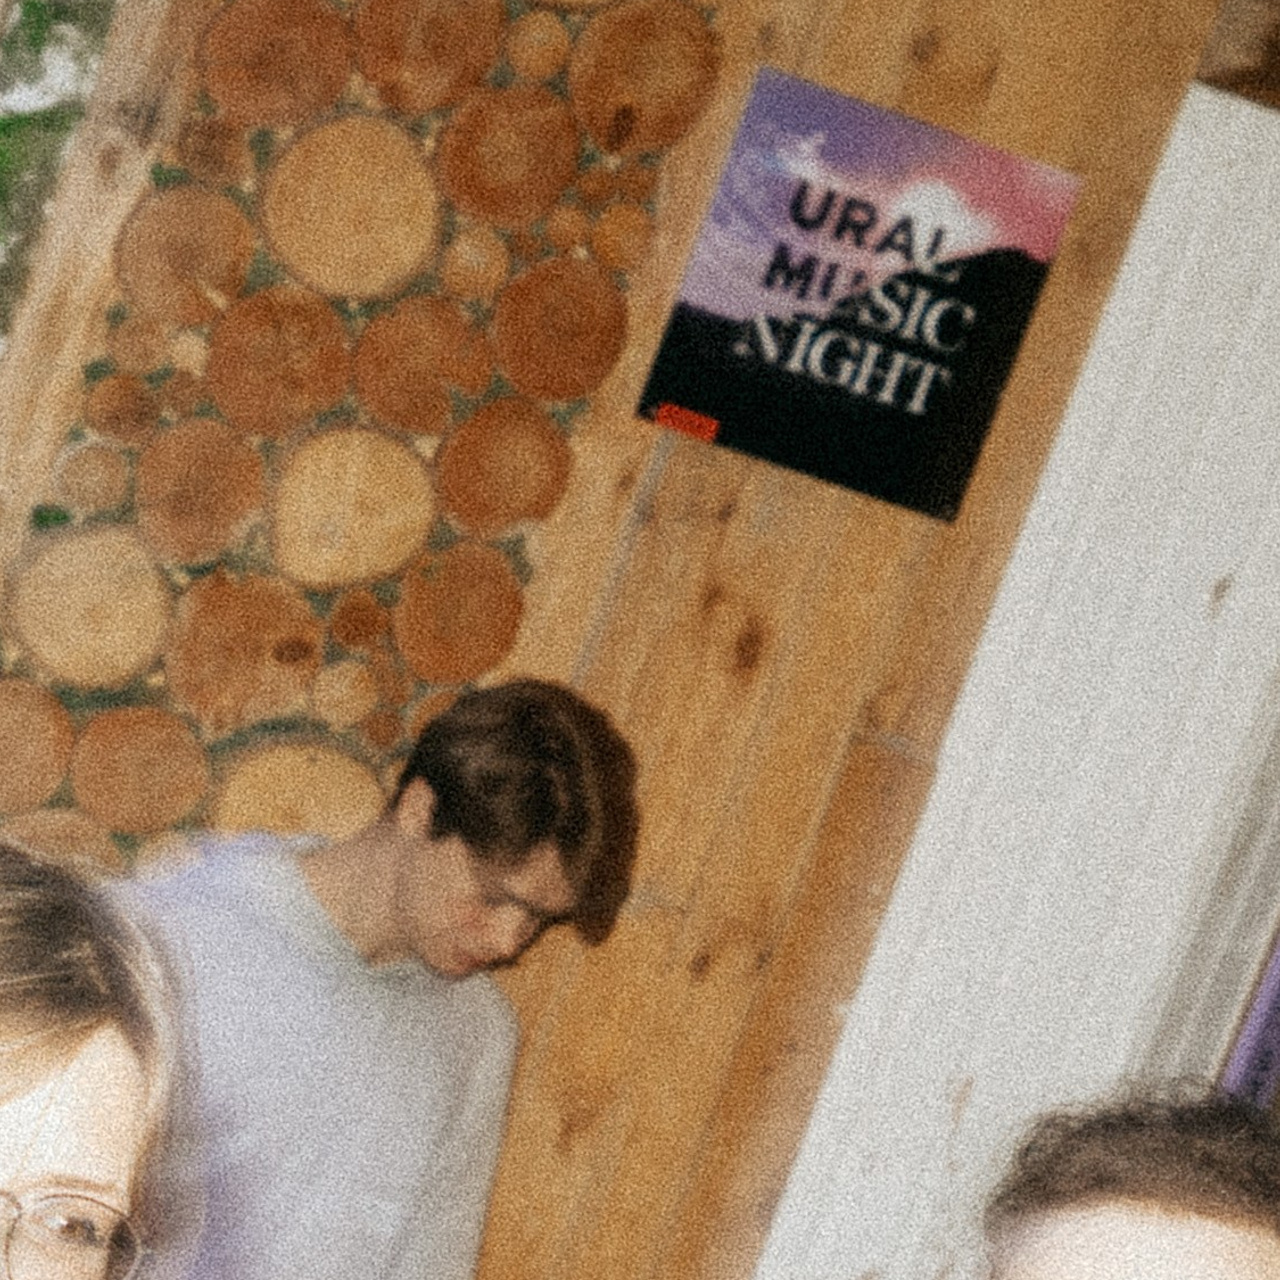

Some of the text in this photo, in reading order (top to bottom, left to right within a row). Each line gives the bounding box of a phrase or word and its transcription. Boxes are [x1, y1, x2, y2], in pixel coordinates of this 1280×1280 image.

[788, 178, 962, 283] URAL
[762, 242, 976, 351] MUSIC
[732, 312, 952, 416] NIGHT
